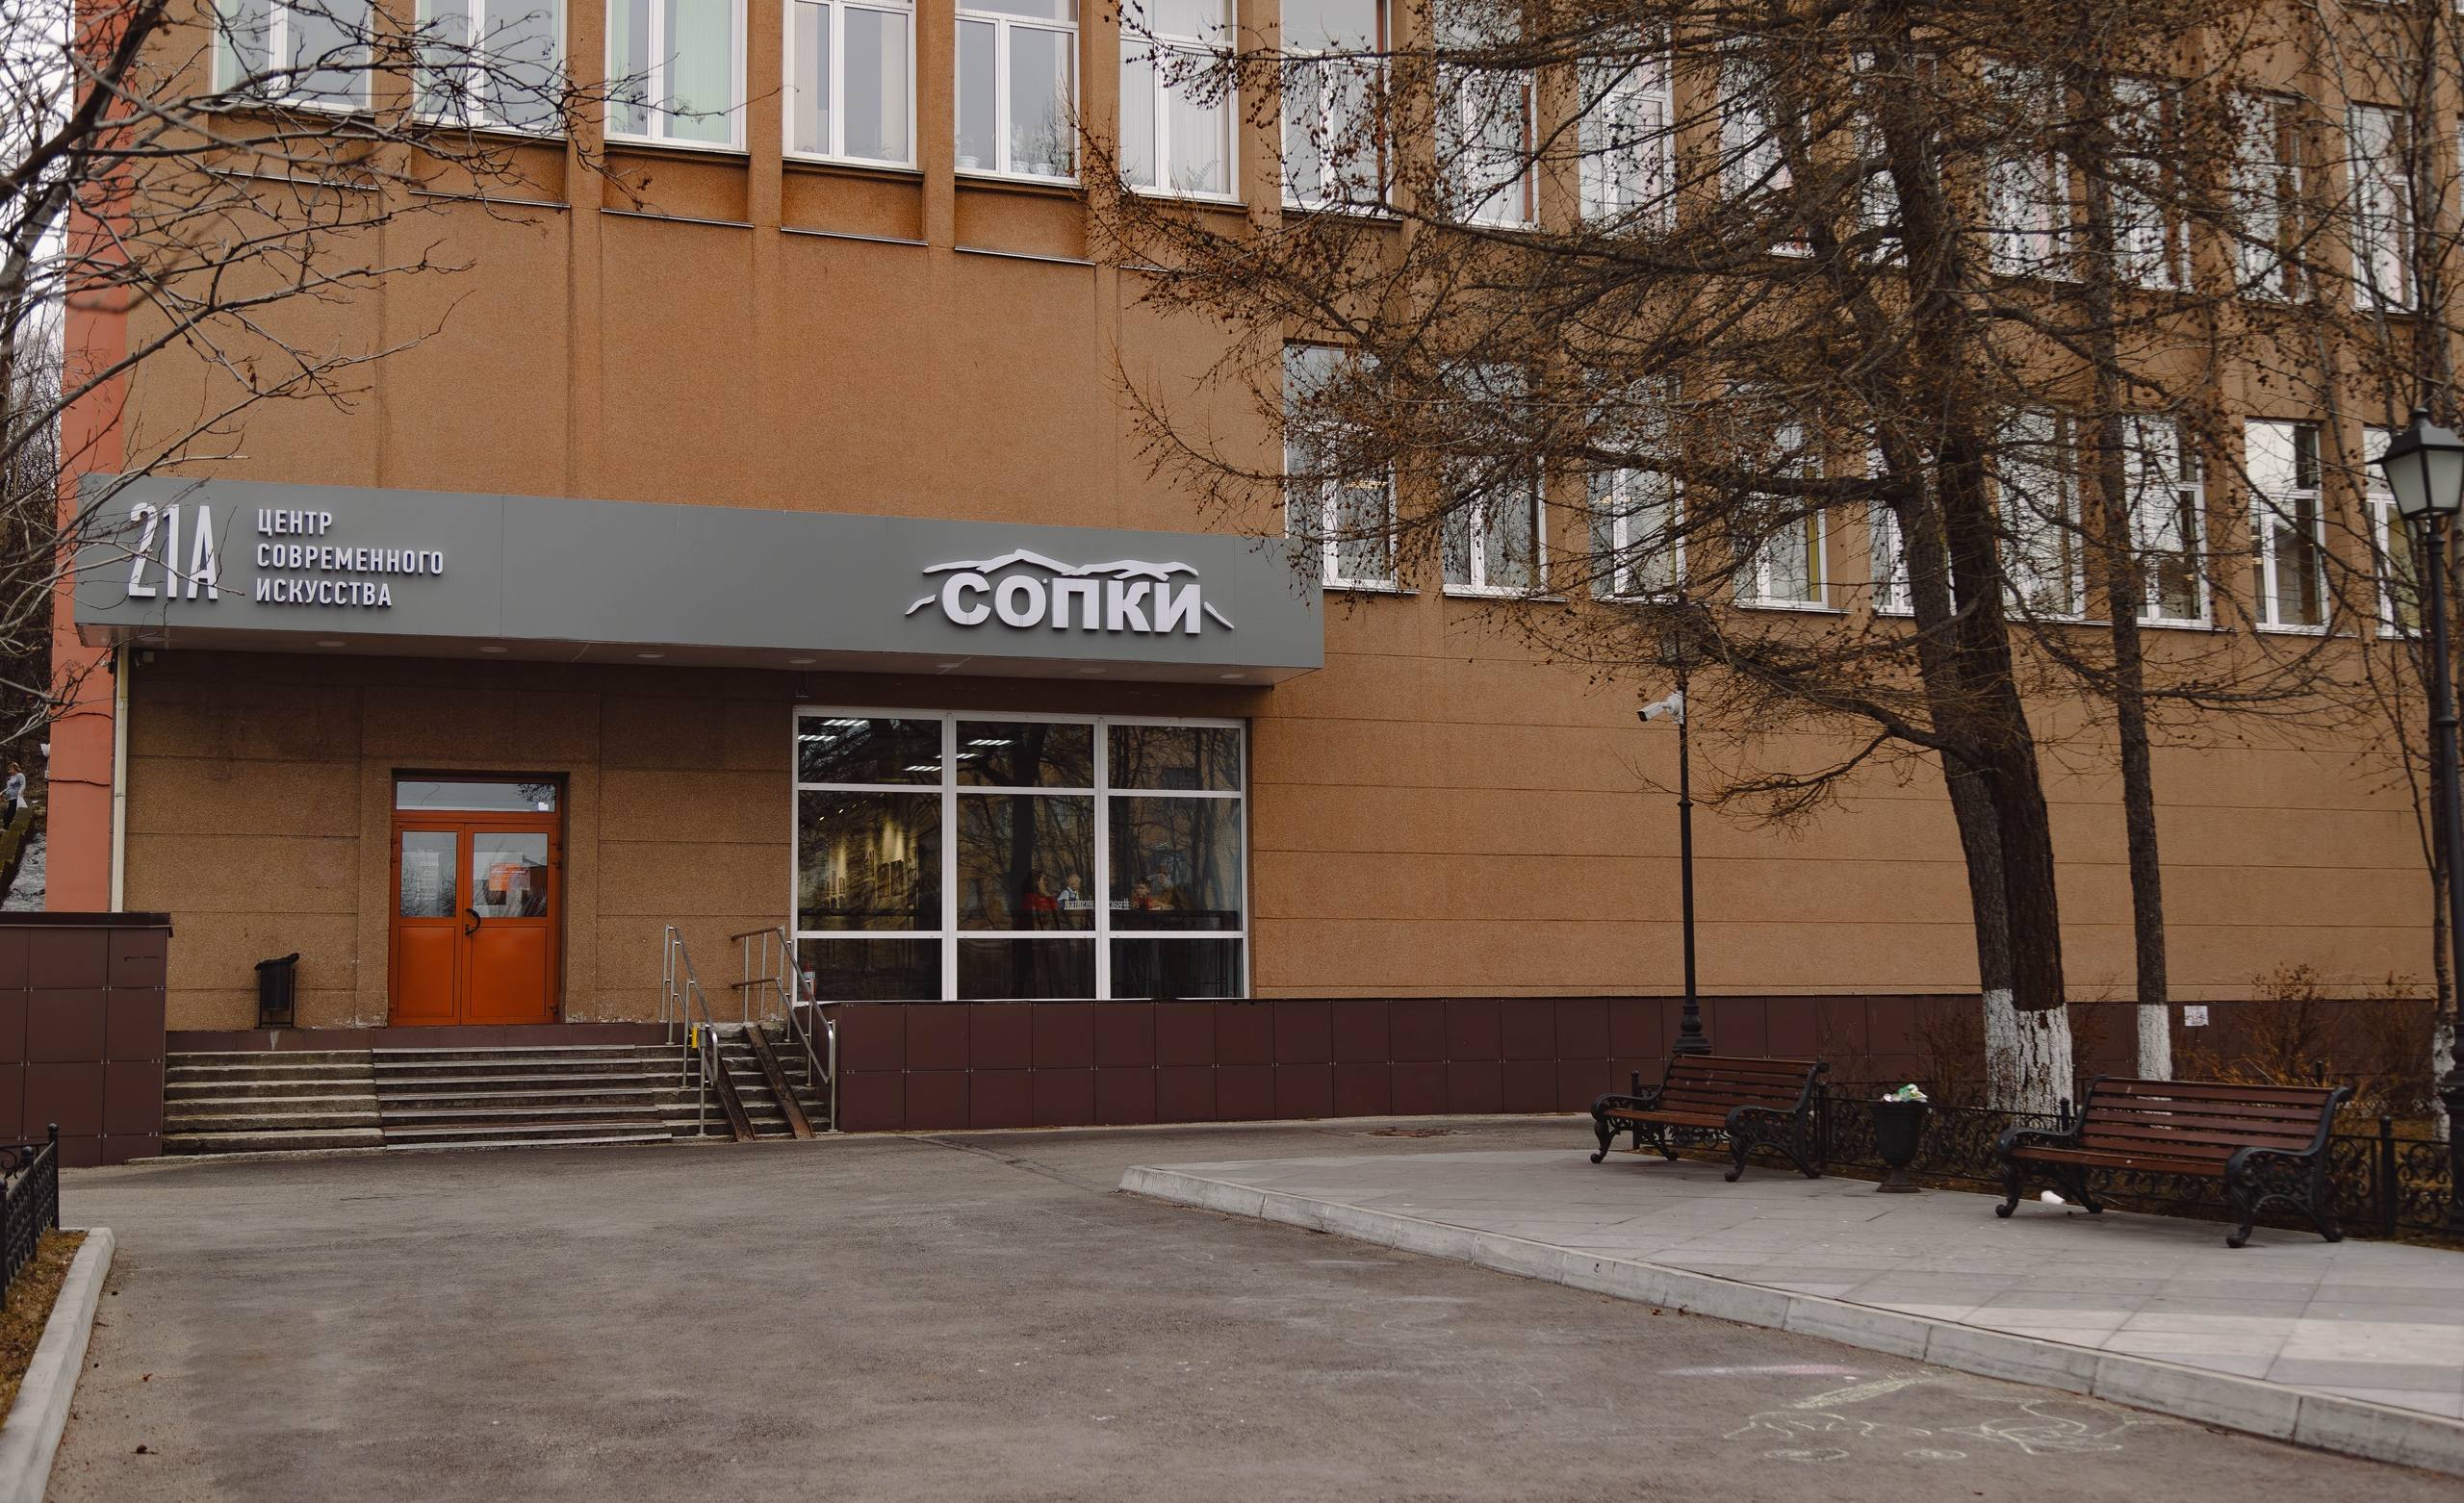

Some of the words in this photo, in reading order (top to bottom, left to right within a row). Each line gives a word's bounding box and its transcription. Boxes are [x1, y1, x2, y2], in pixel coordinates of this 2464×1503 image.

[257, 508, 332, 536] ЦЕНТР
[256, 543, 444, 575] СОВРЕМЕННОГО
[255, 577, 392, 606] ИСКУССТВА
[941, 573, 1201, 634] СОПКИ
